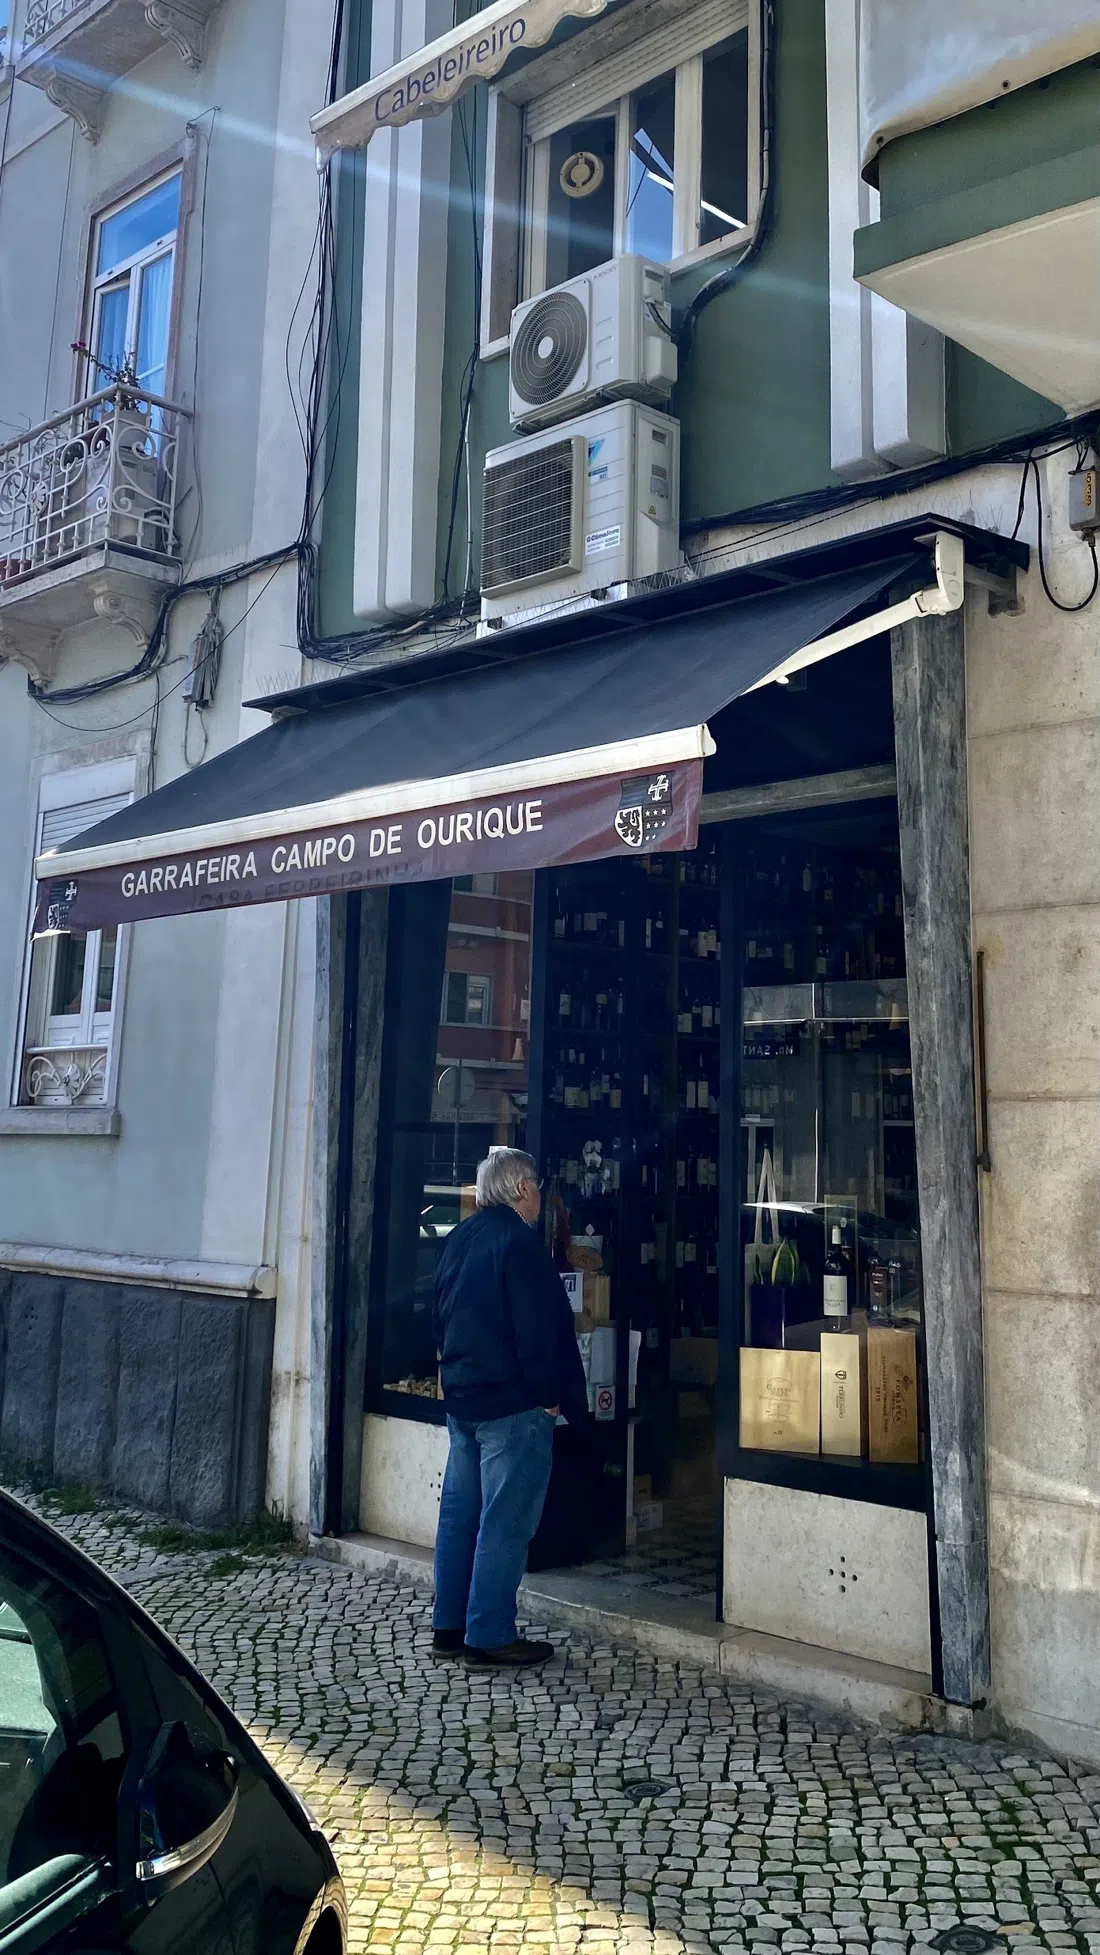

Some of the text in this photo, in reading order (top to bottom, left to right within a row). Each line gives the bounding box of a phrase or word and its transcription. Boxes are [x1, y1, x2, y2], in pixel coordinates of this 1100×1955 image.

[374, 17, 526, 121] Cabeleireiro
[121, 799, 544, 898] GARRAFEIRA CAMPO DE OURIQUE
